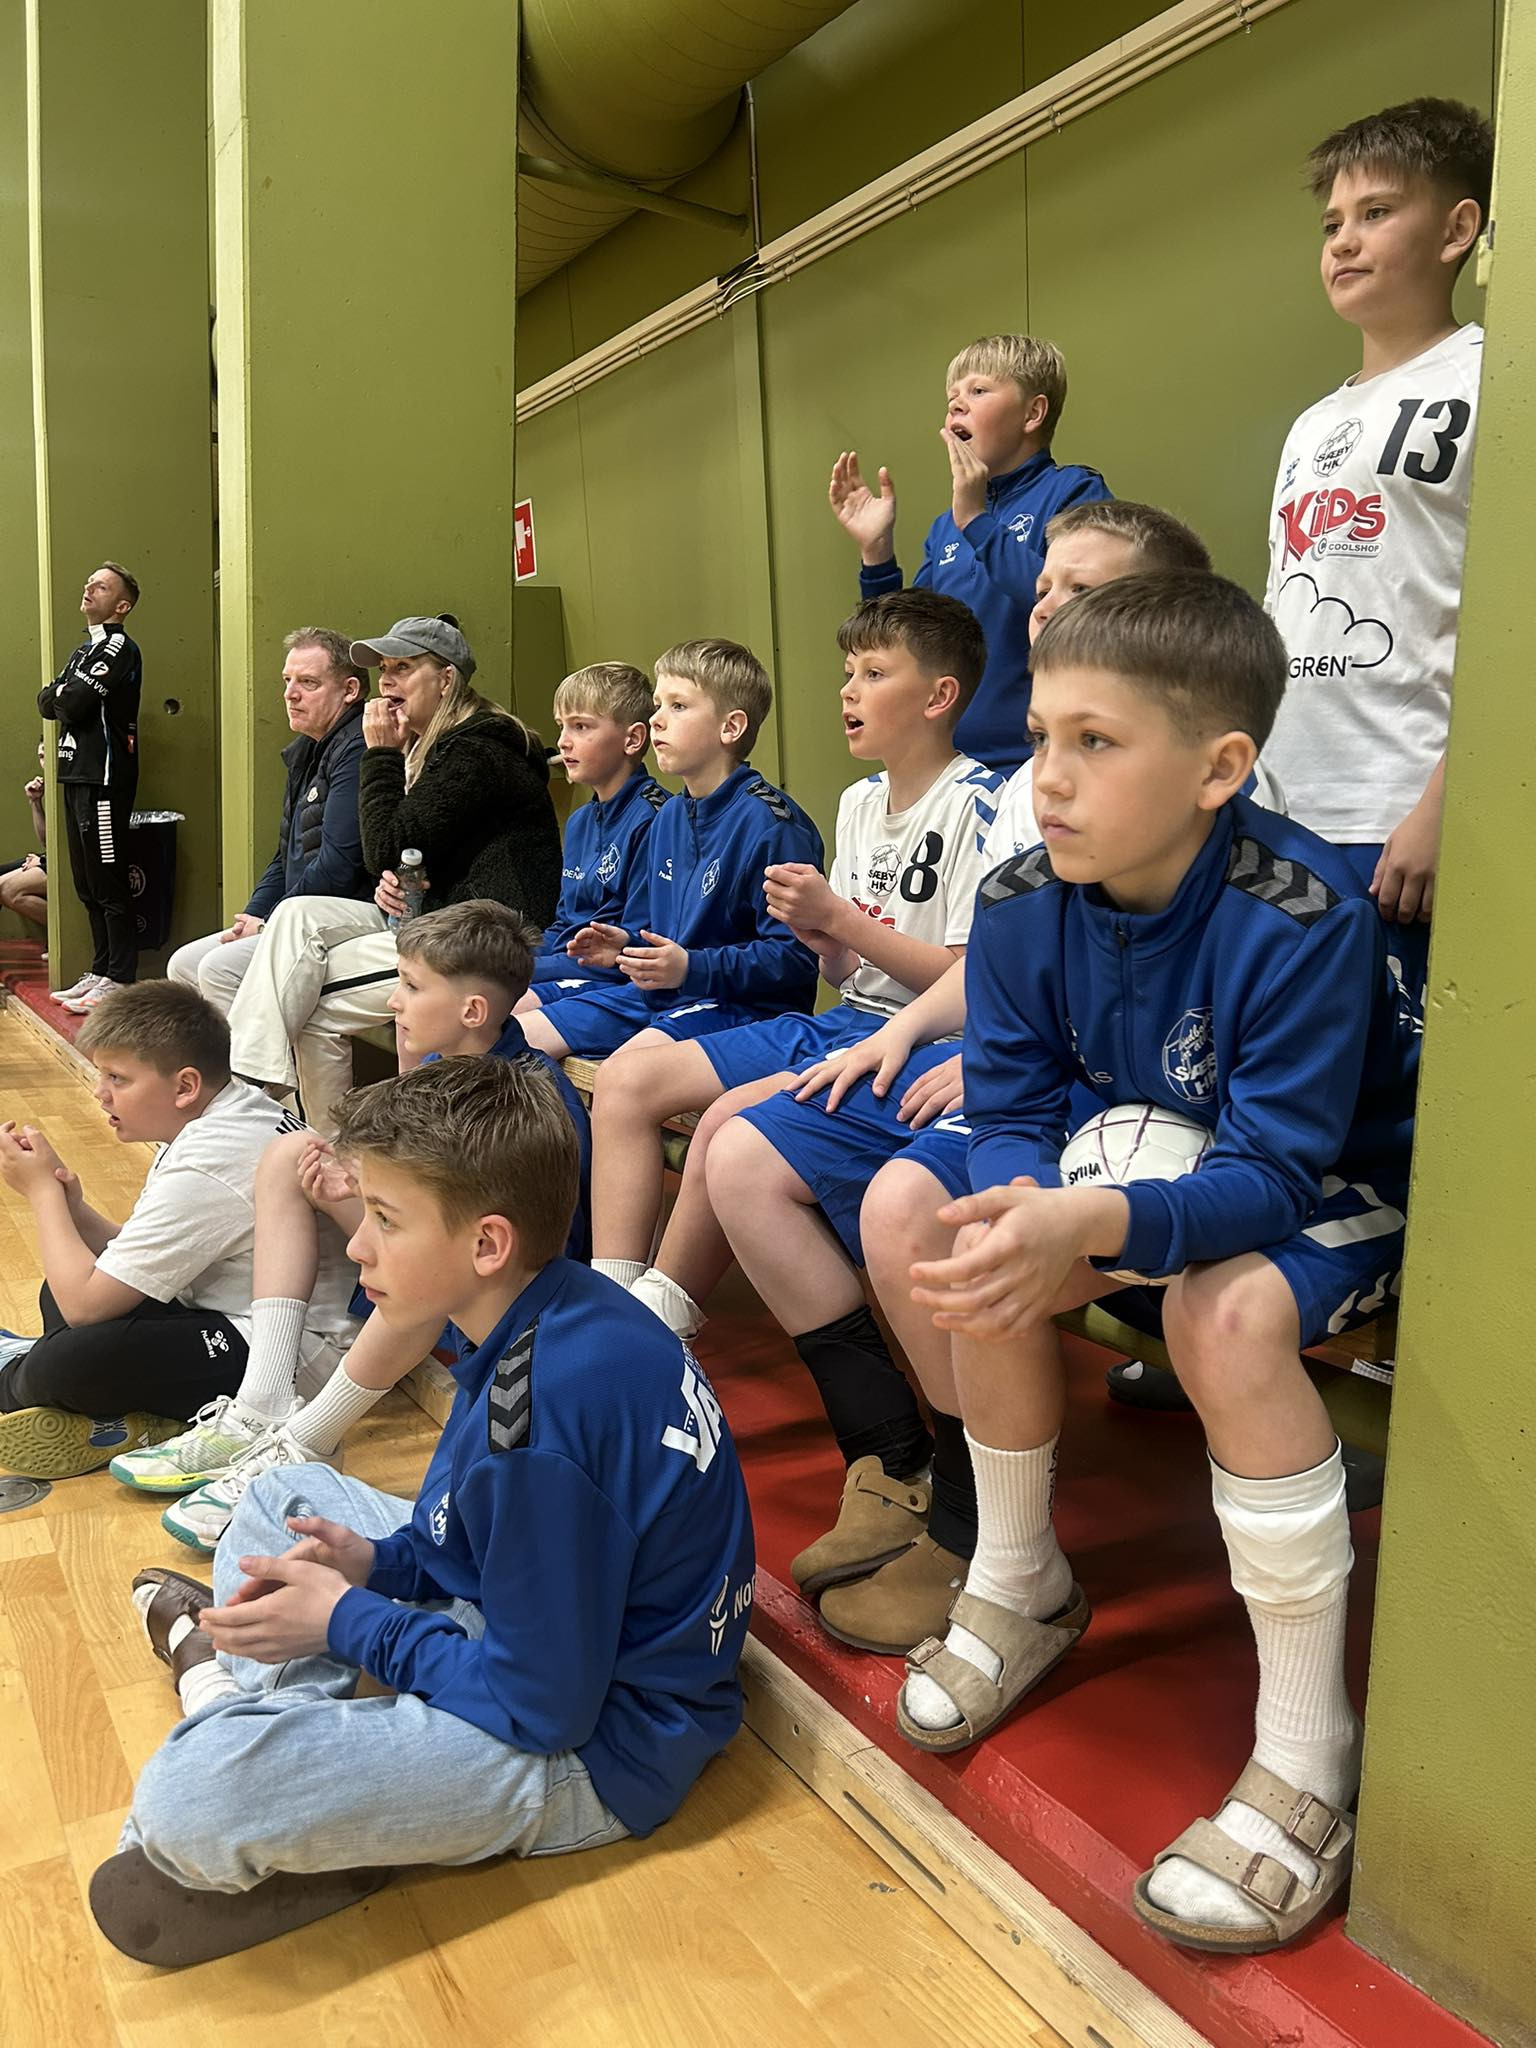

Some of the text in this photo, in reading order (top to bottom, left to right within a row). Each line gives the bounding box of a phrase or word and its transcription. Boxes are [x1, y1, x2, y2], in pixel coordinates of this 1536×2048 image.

[1377, 399, 1471, 484] 13
[1318, 445, 1353, 462] SÆBY
[1322, 459, 1340, 471] HK
[1328, 543, 1380, 553] COOLSHOP
[900, 831, 943, 903] 8
[868, 869, 896, 881] SÆBY
[871, 880, 887, 891] HK
[1175, 1052, 1217, 1081] SÆB
